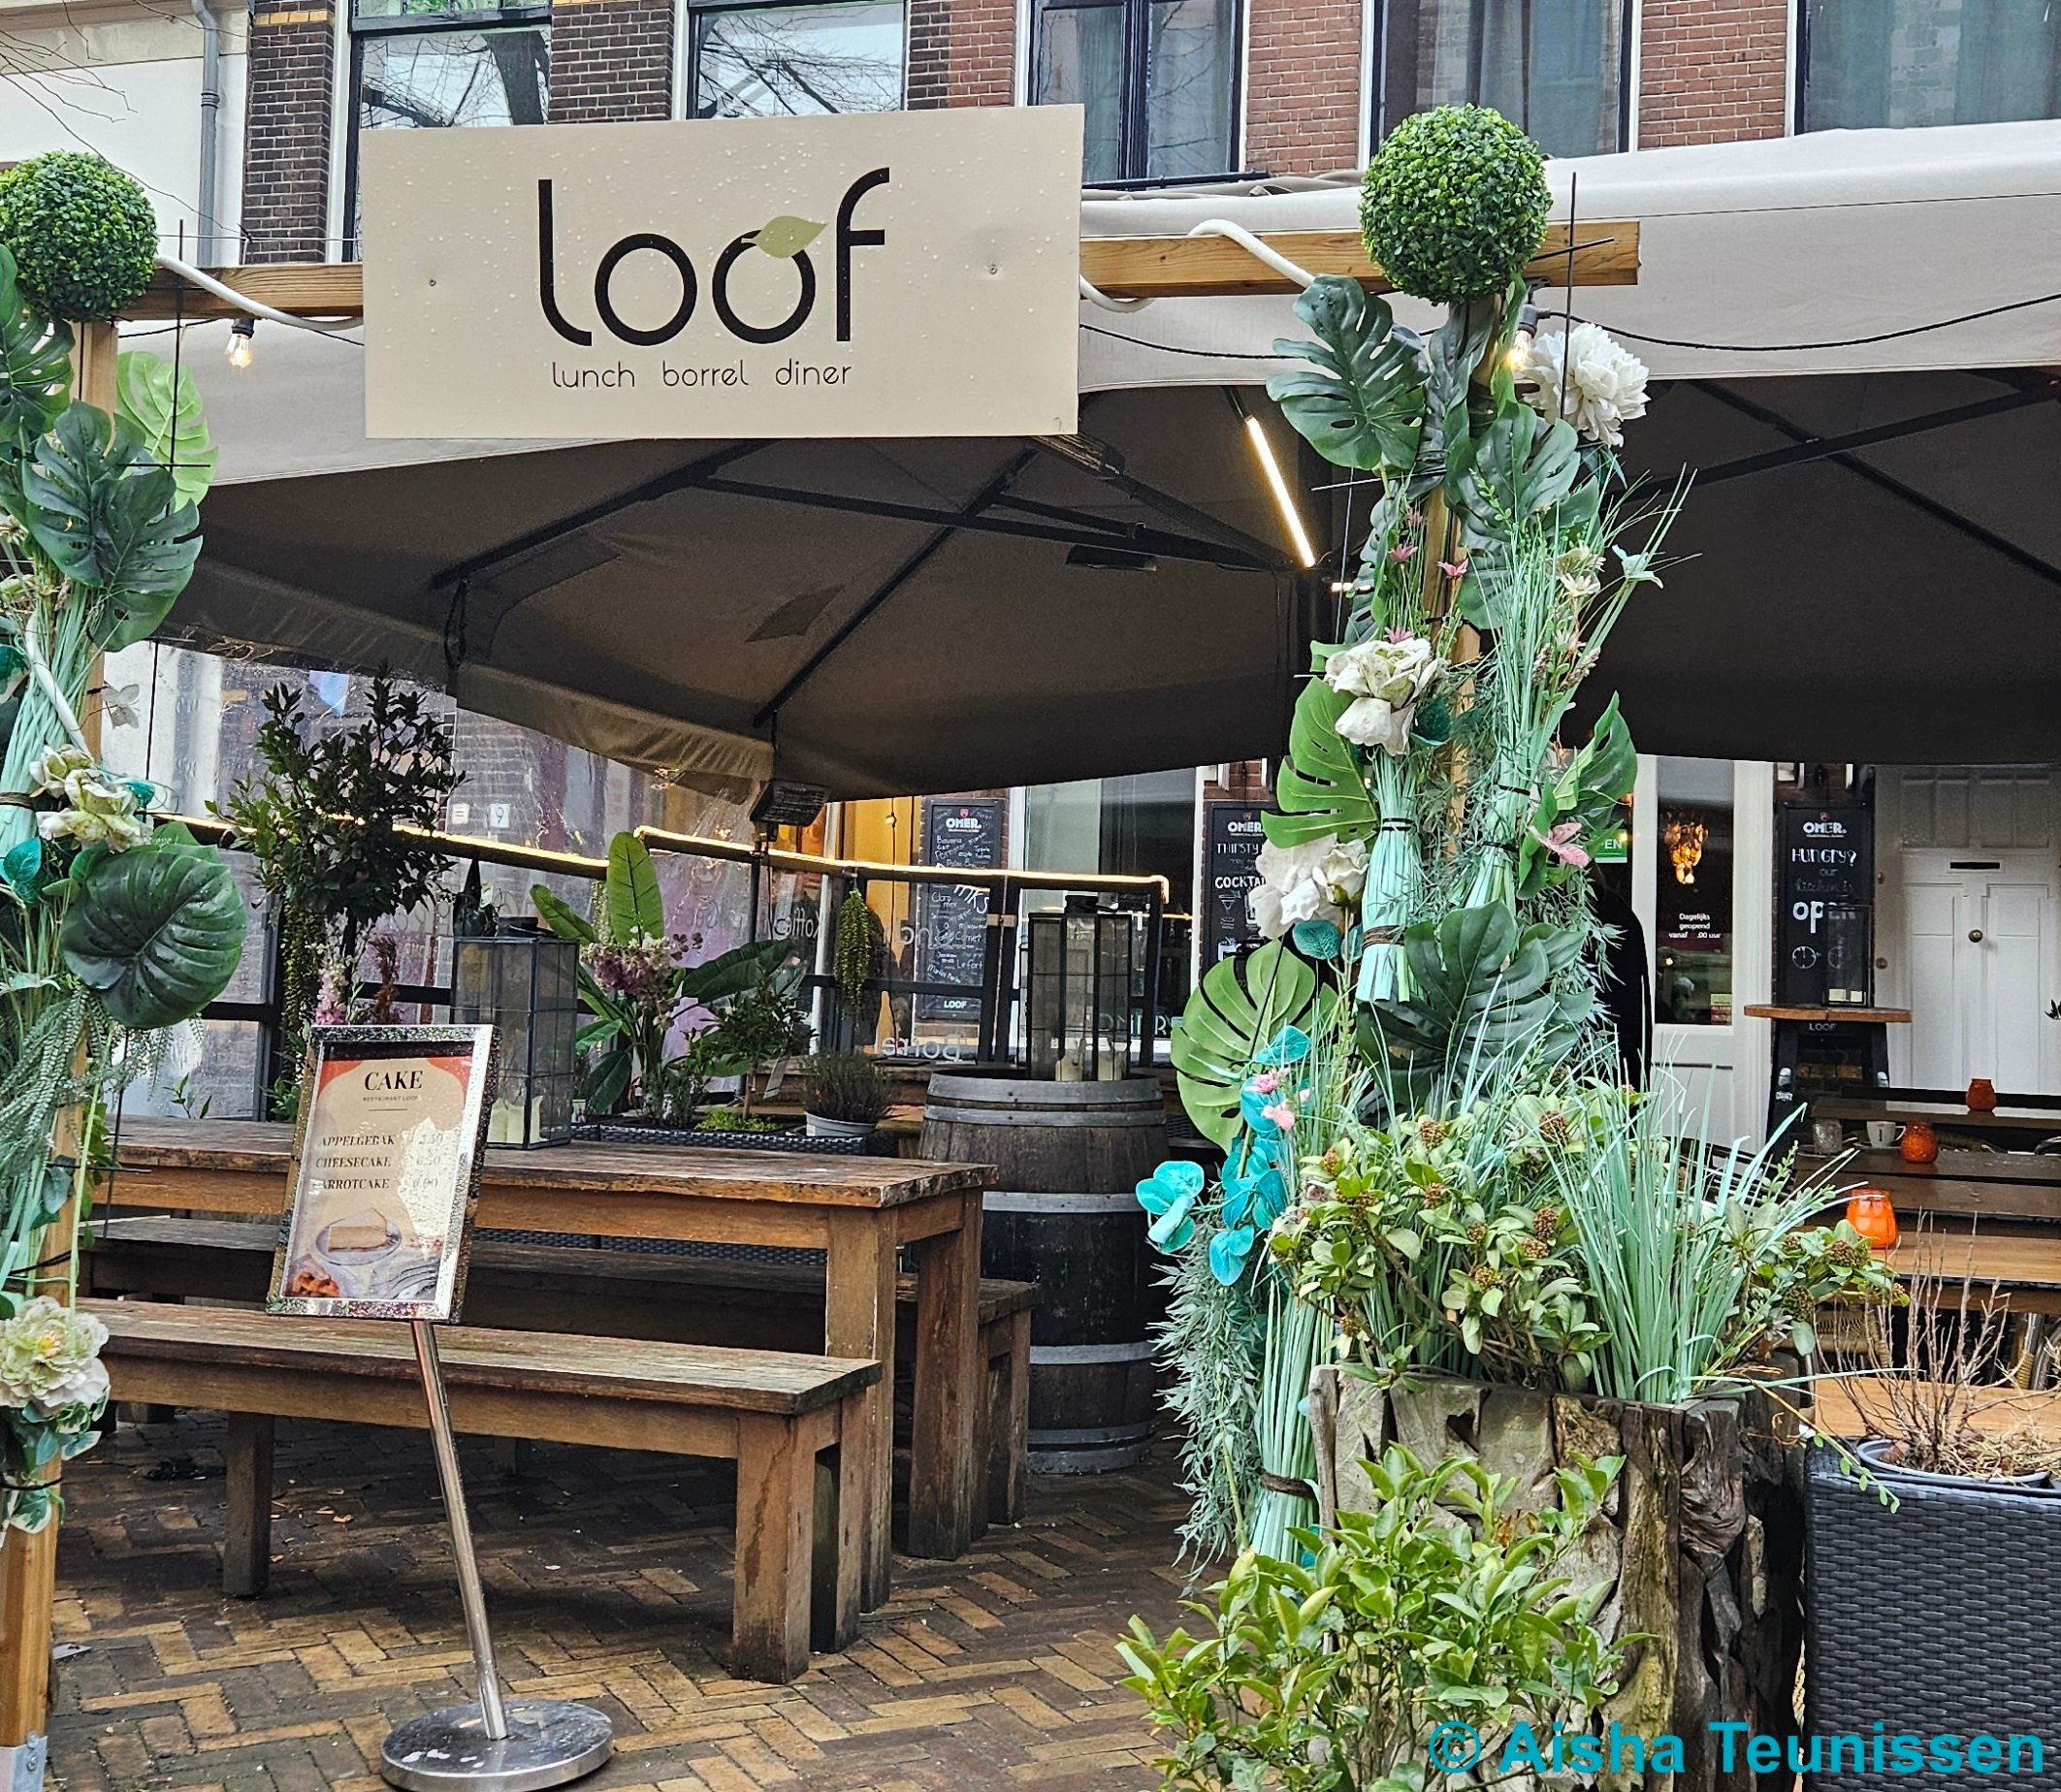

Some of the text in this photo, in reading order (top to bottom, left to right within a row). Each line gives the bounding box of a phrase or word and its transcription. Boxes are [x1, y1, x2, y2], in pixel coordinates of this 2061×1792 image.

[537, 167, 889, 346] loof
[551, 360, 852, 388] lunch borrel diner
[1214, 876, 1266, 889] COCKTAI
[1679, 912, 1710, 922] Dagelijks
[1679, 922, 1710, 931] geopend
[1809, 1022, 1837, 1031] LOOF
[365, 1071, 423, 1090] CAKE
[315, 1156, 392, 1168] CHEESECAKE
[315, 1178, 390, 1190] ARROTCAKE
